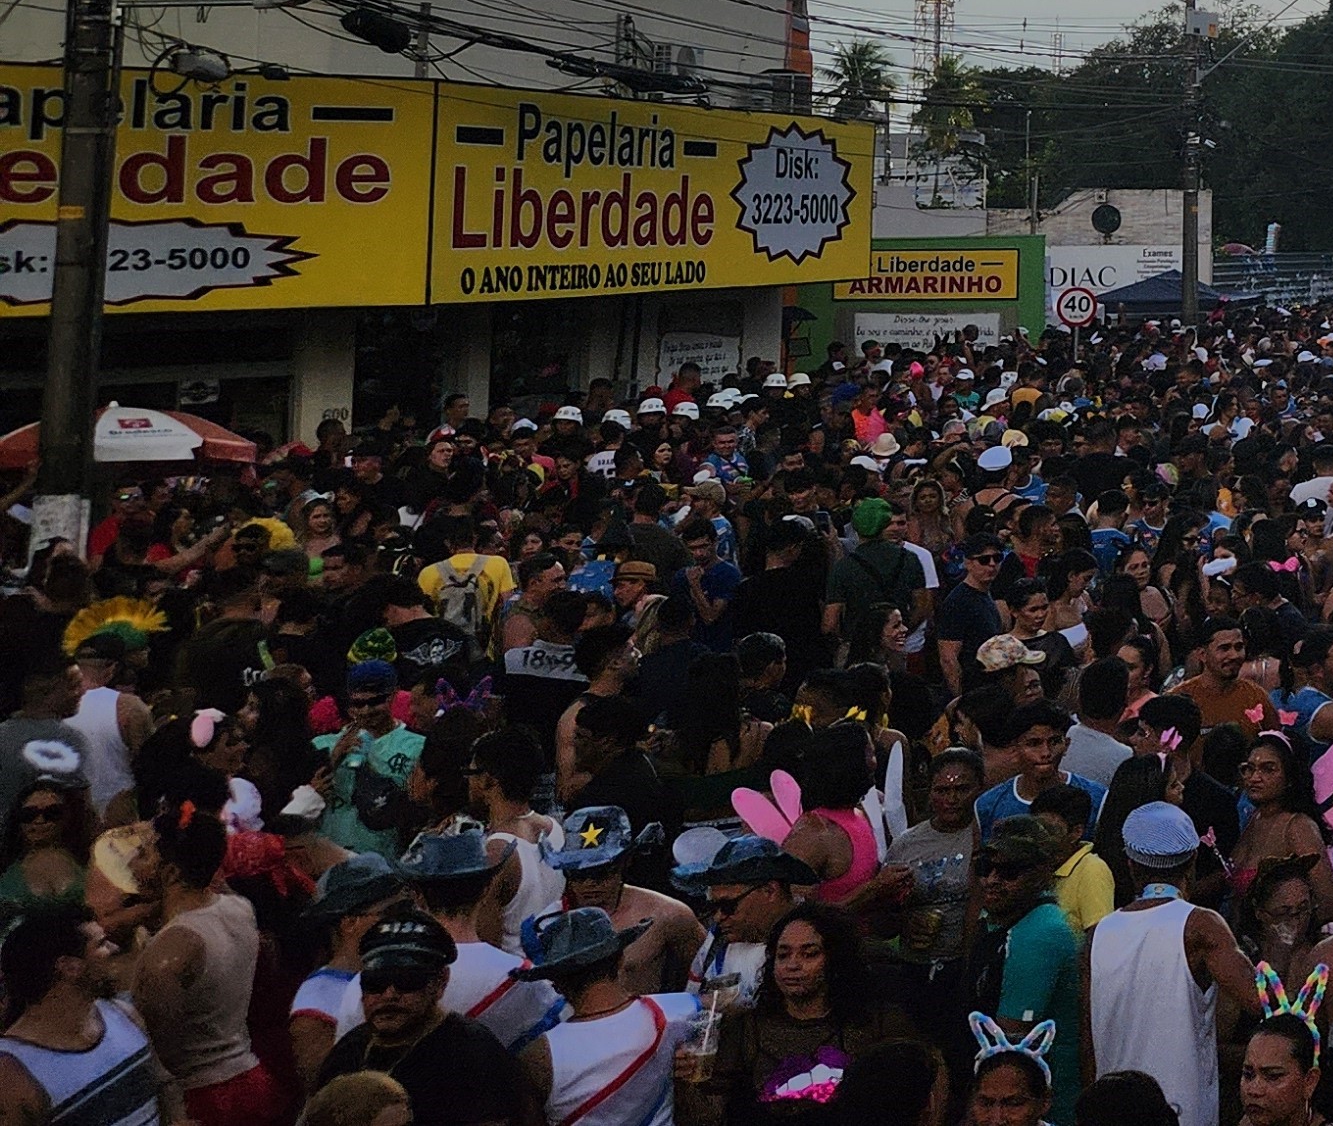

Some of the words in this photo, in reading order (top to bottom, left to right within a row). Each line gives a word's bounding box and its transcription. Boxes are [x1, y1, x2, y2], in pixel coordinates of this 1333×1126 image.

[0, 79, 290, 140] aplaria
[517, 103, 675, 176] Papelaria
[0, 135, 391, 204] edade
[775, 148, 819, 179] Disk:
[452, 166, 715, 249] Liberdade
[752, 193, 839, 225] 3223-5000
[109, 247, 250, 271] 23-5000
[876, 256, 976, 274] Liberdade
[1142, 248, 1173, 258] Exames
[461, 267, 475, 295] O
[479, 265, 521, 293] ANO
[527, 263, 599, 291] INTEIRO
[604, 262, 629, 287] AO
[631, 261, 662, 286] SEU
[665, 259, 707, 284] LADO
[849, 275, 1002, 295] ARMARINHO
[1063, 295, 1091, 313] 40
